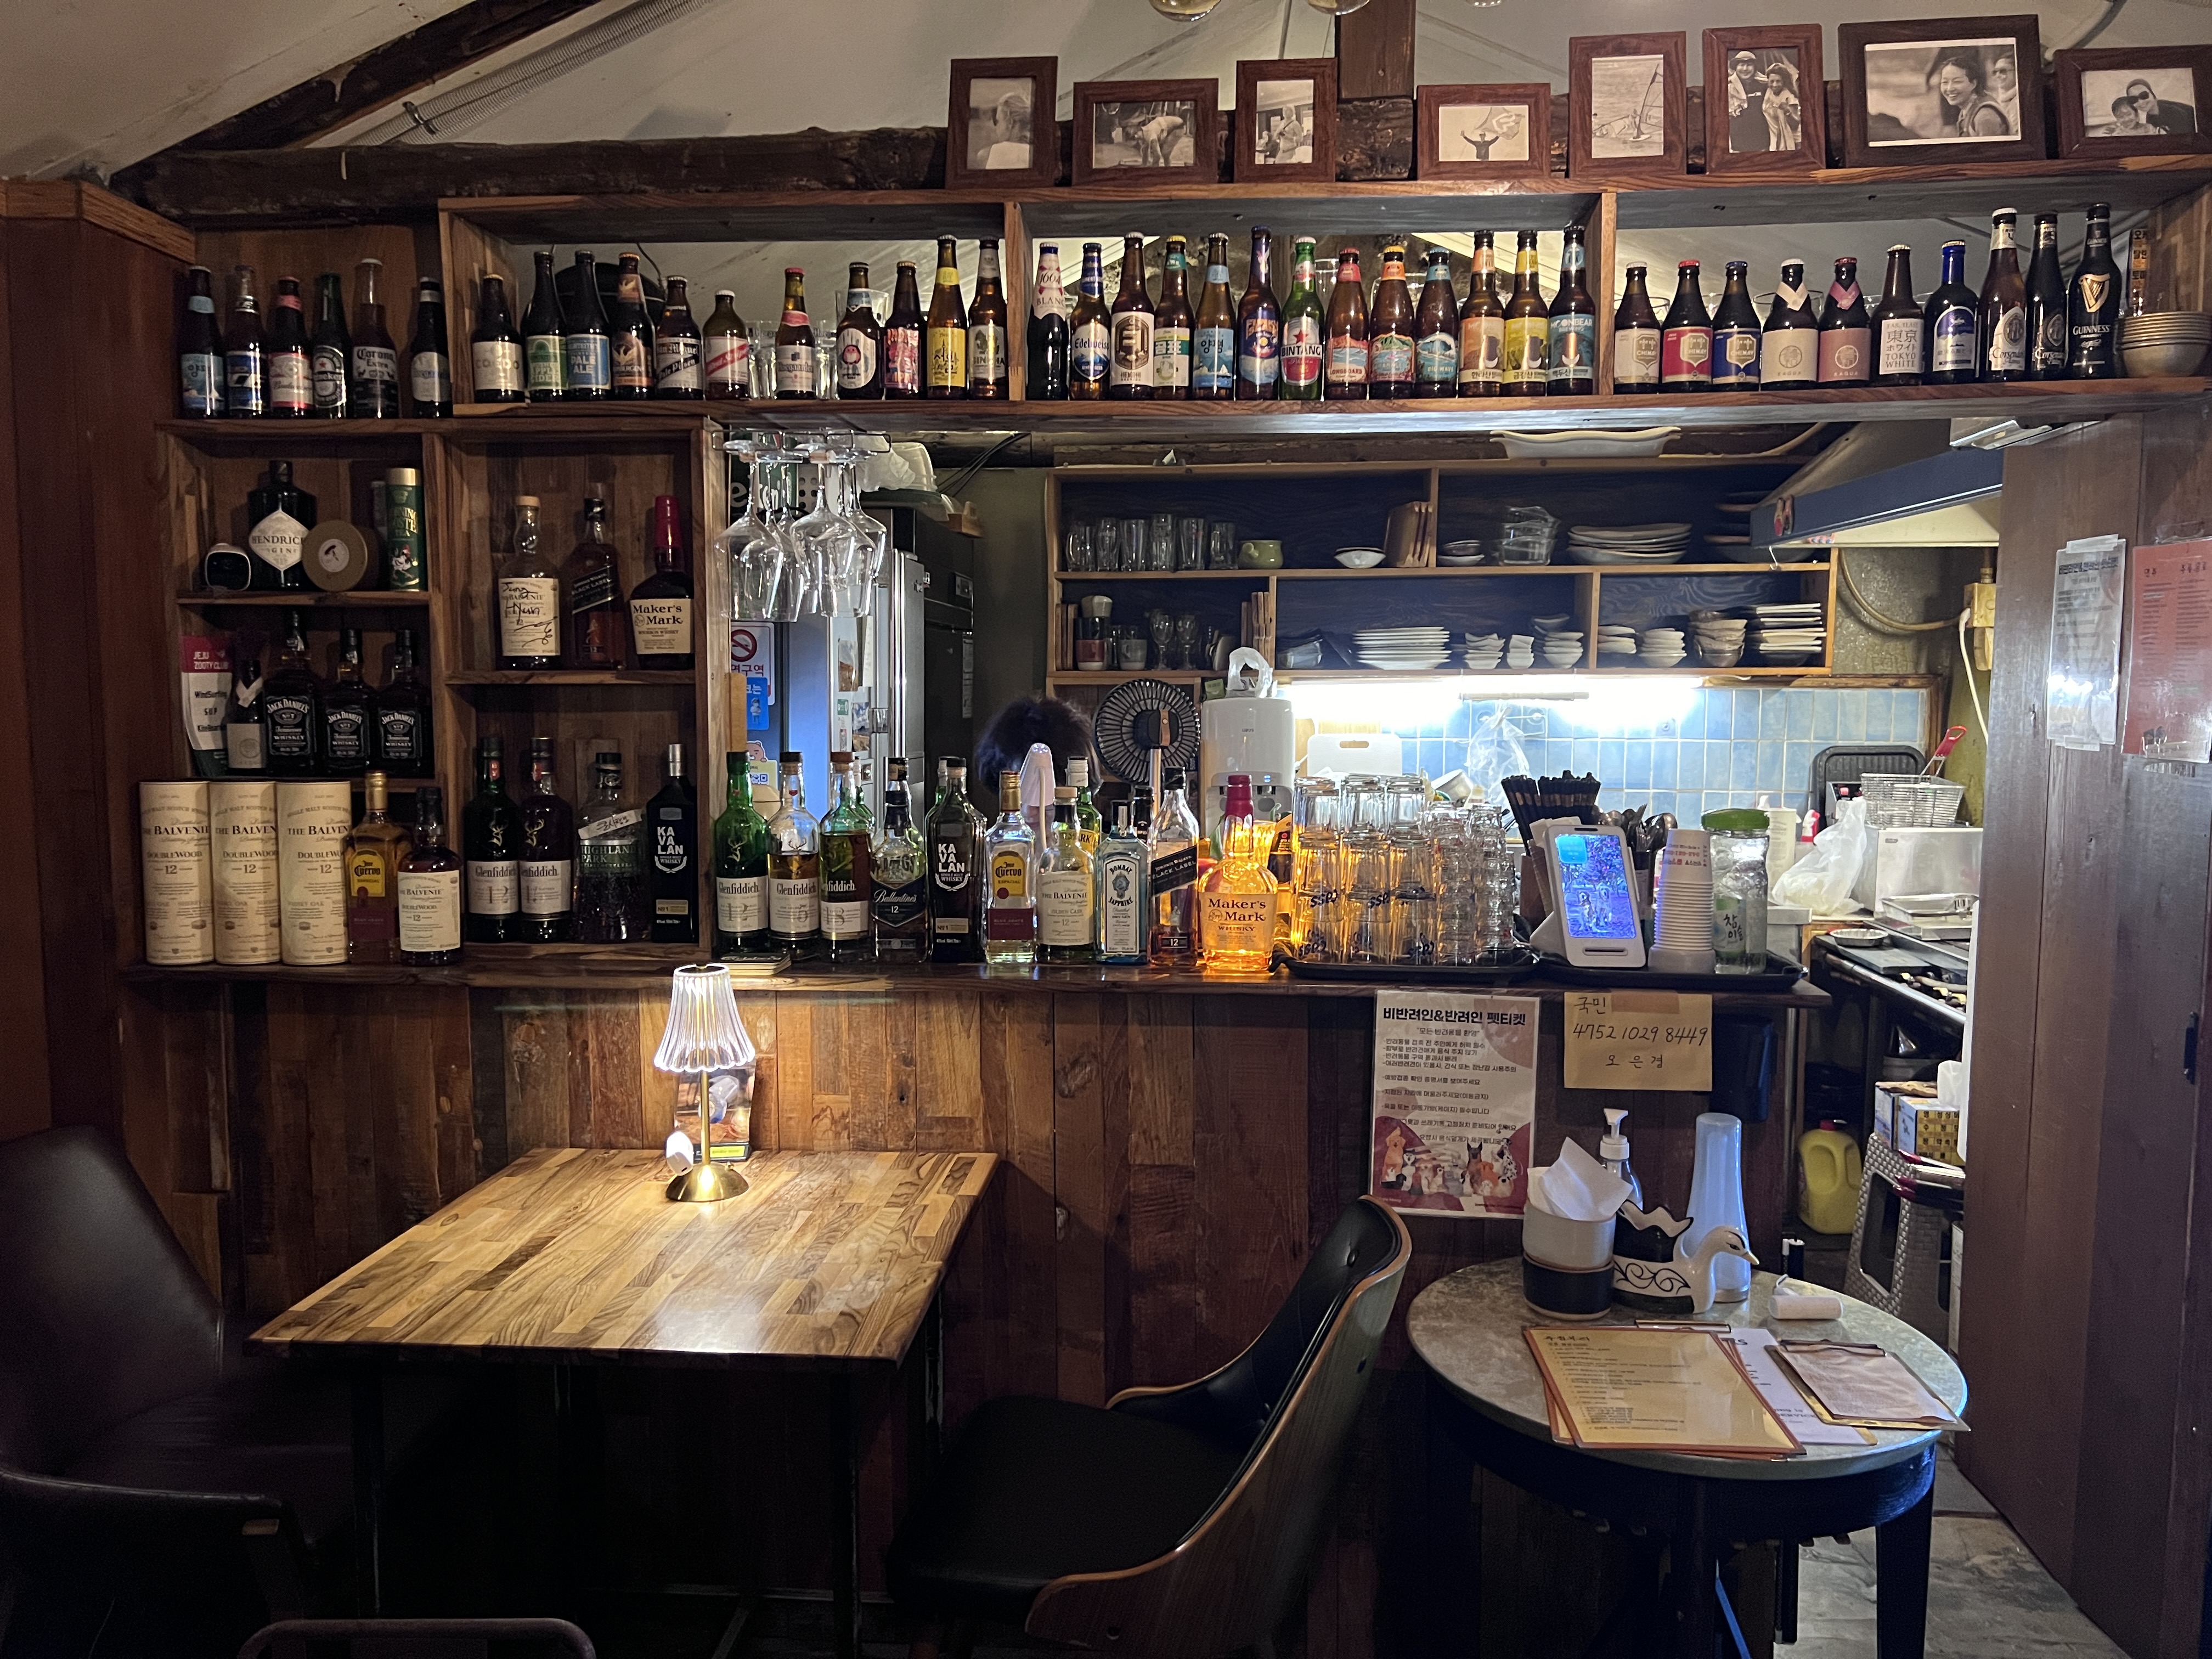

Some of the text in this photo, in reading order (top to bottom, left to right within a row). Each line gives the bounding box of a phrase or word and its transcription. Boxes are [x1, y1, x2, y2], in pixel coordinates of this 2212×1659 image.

[1036, 297, 1065, 307] BLANC
[2073, 324, 2111, 335] GUINNESS
[1886, 330, 1918, 343] 東京
[357, 348, 394, 362] Corona
[1282, 345, 1321, 357] BINTANG
[571, 355, 596, 366] PALE
[573, 364, 593, 374] ALE
[633, 605, 682, 614] Maker's
[646, 616, 683, 625] Mark
[657, 826, 675, 836] KA
[657, 836, 675, 846] VA
[581, 845, 637, 855] HIGHLAND
[657, 845, 684, 855] LAN
[938, 843, 956, 854] KA
[581, 854, 607, 864] PARK
[938, 854, 957, 864] VA
[165, 865, 178, 874] 12
[244, 864, 257, 874] 12
[319, 864, 332, 874] 12
[354, 865, 381, 877] Cuervo
[938, 862, 966, 873] LAN
[1108, 864, 1133, 875] BOMBAY
[1172, 859, 1196, 872] LABEL
[995, 865, 1022, 878] Cuervo
[776, 882, 817, 895] Glenfiddich
[873, 889, 917, 904] Ballantine's
[1053, 891, 1089, 900] BALVENIE
[1207, 898, 1267, 910] Maker's
[890, 906, 899, 914] 12
[1223, 910, 1267, 922] Mark
[1723, 914, 1737, 928] 참
[1217, 924, 1256, 933] WHISKY
[1169, 938, 1179, 947] 12
[1573, 996, 1607, 1015] 국민
[1383, 1007, 1526, 1026] 비반려인&반려인 펫티켓
[1572, 1024, 1708, 1047] 4752 1029 8449
[1605, 1054, 1620, 1066] 오
[1628, 1055, 1643, 1068] 은
